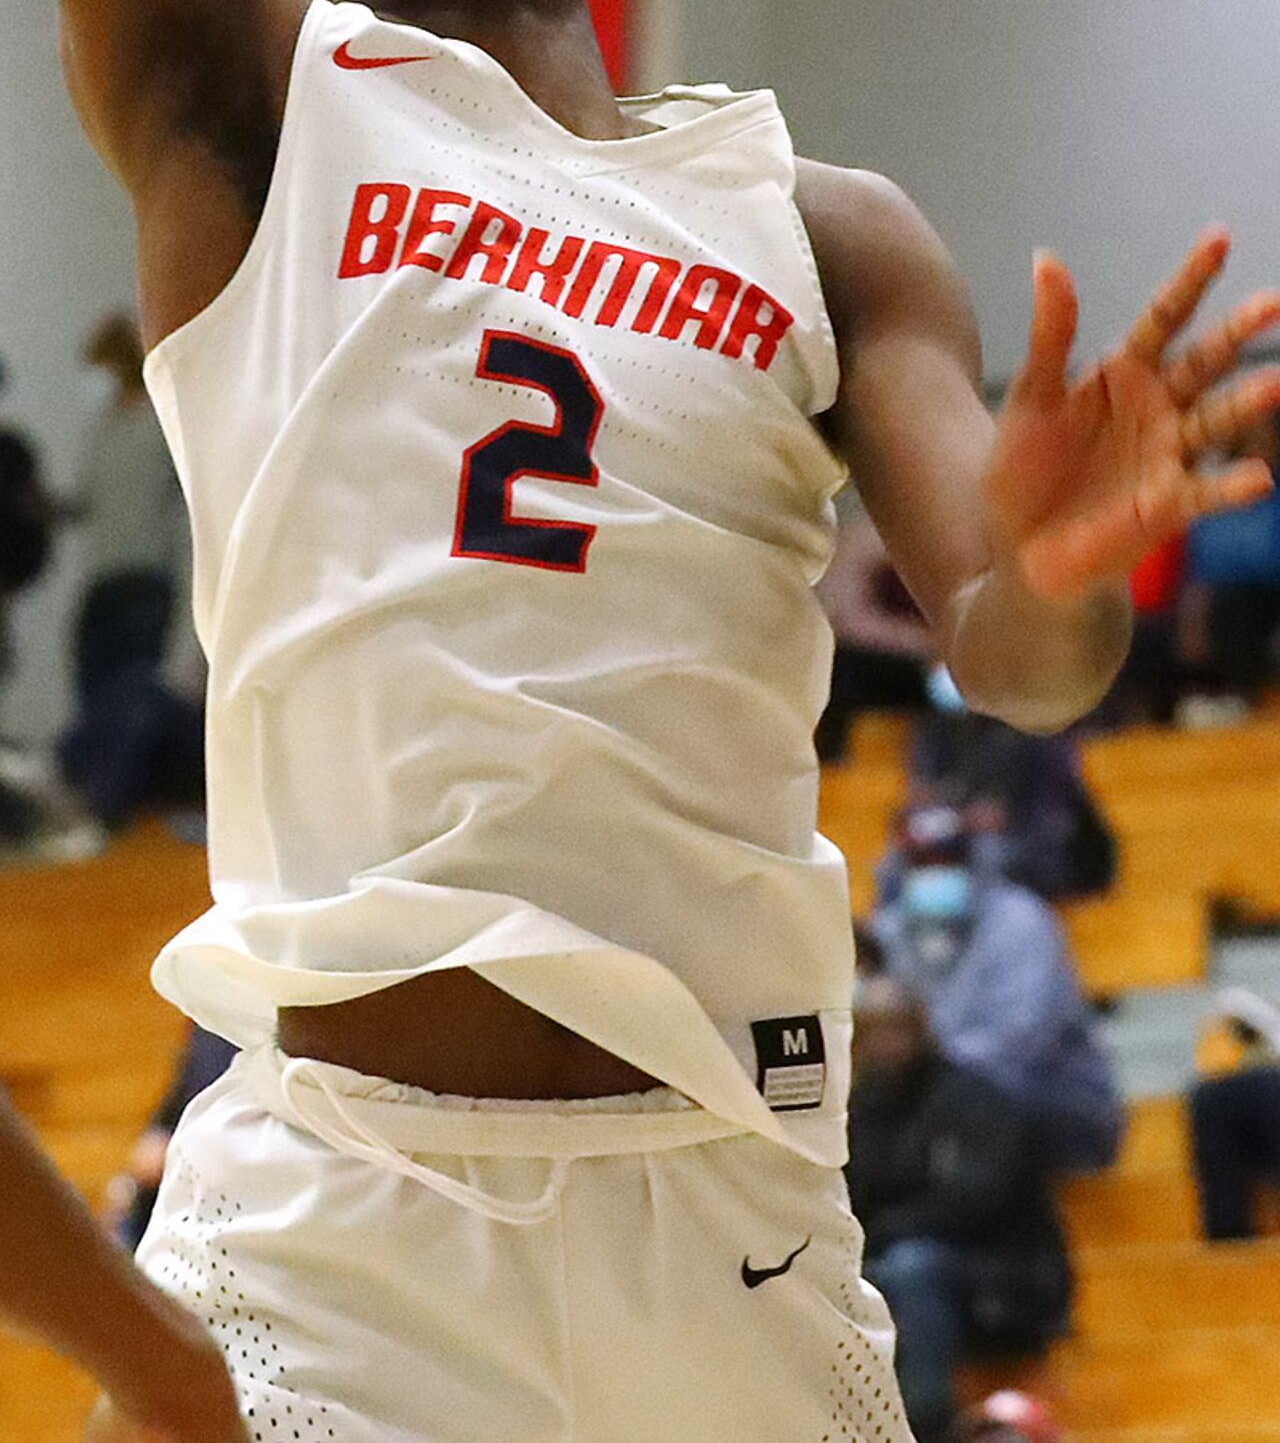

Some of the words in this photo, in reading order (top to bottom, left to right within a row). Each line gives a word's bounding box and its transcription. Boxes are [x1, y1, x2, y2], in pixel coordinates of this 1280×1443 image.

[338, 183, 794, 372] BERKMAR
[451, 329, 605, 574] 2
[782, 1028, 809, 1056] M
